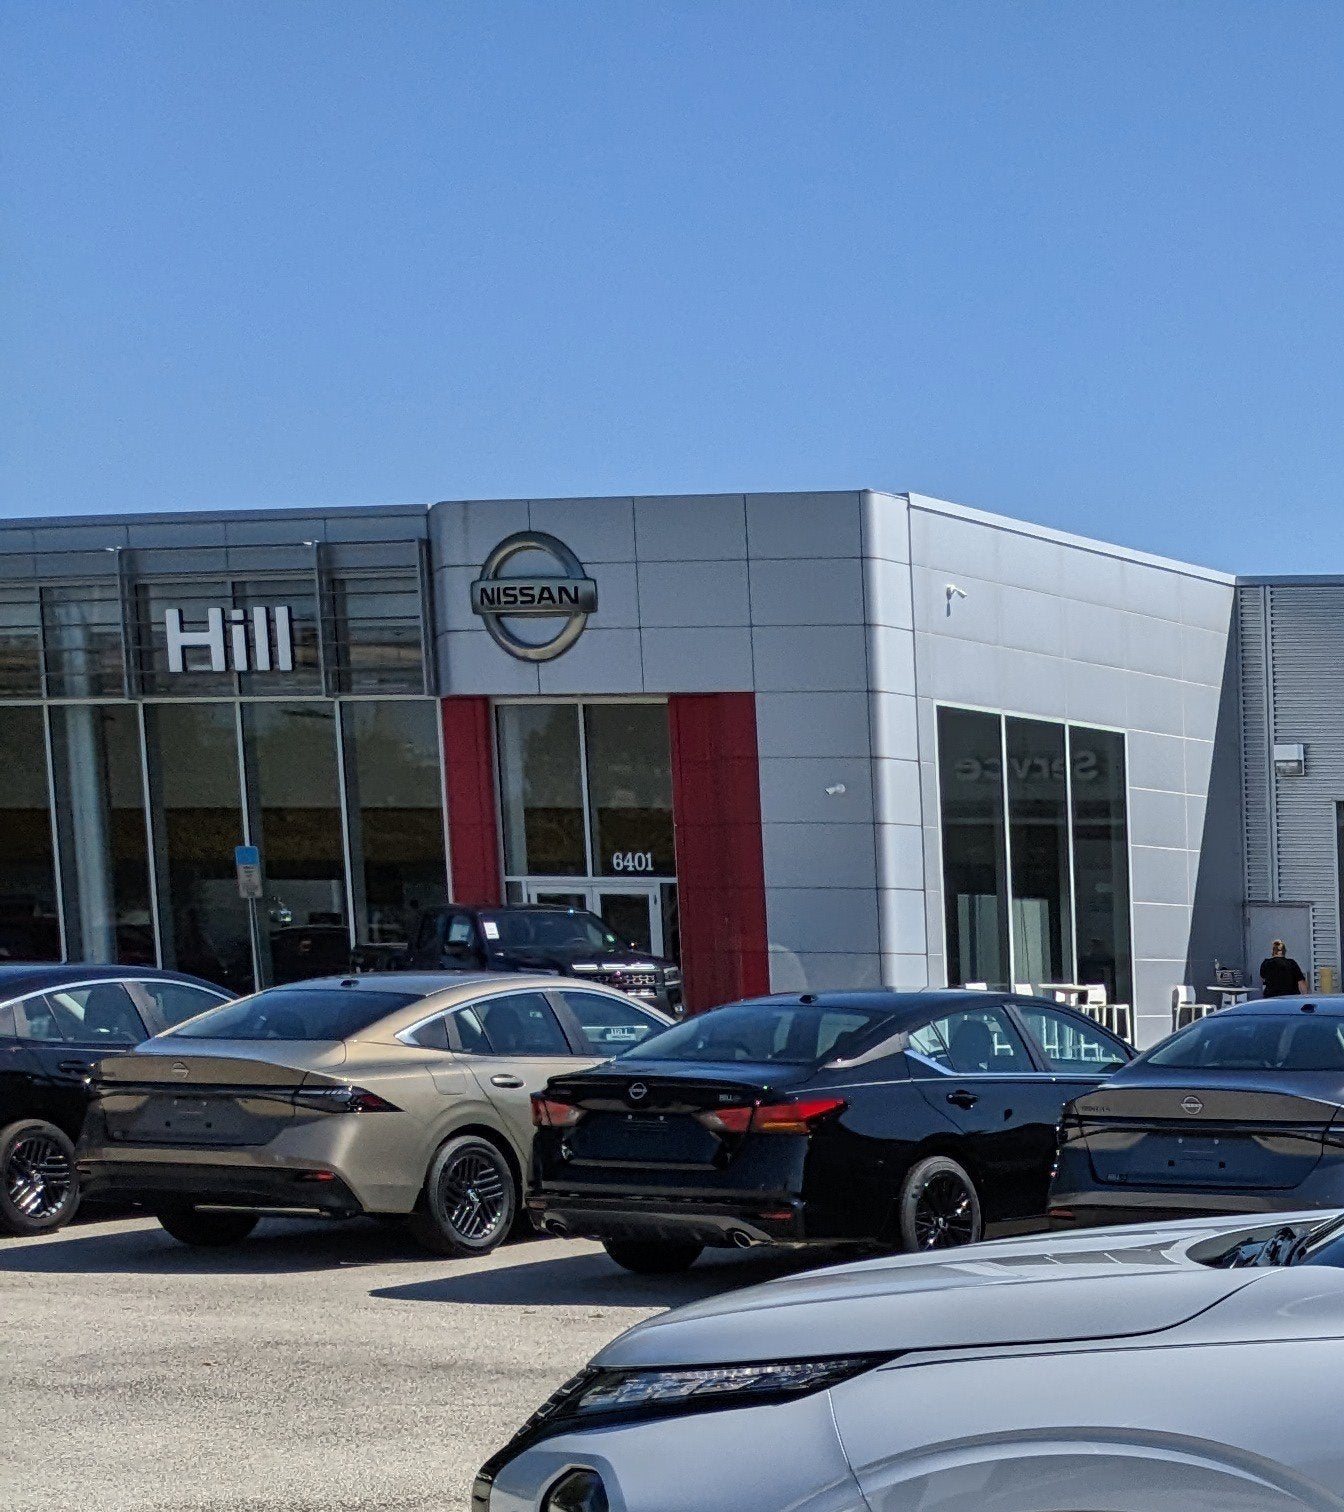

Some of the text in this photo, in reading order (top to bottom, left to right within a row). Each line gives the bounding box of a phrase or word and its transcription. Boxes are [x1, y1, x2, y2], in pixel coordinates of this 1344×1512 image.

[479, 585, 580, 606] NISSAN
[165, 605, 294, 673] Hill
[612, 851, 654, 872] 6401
